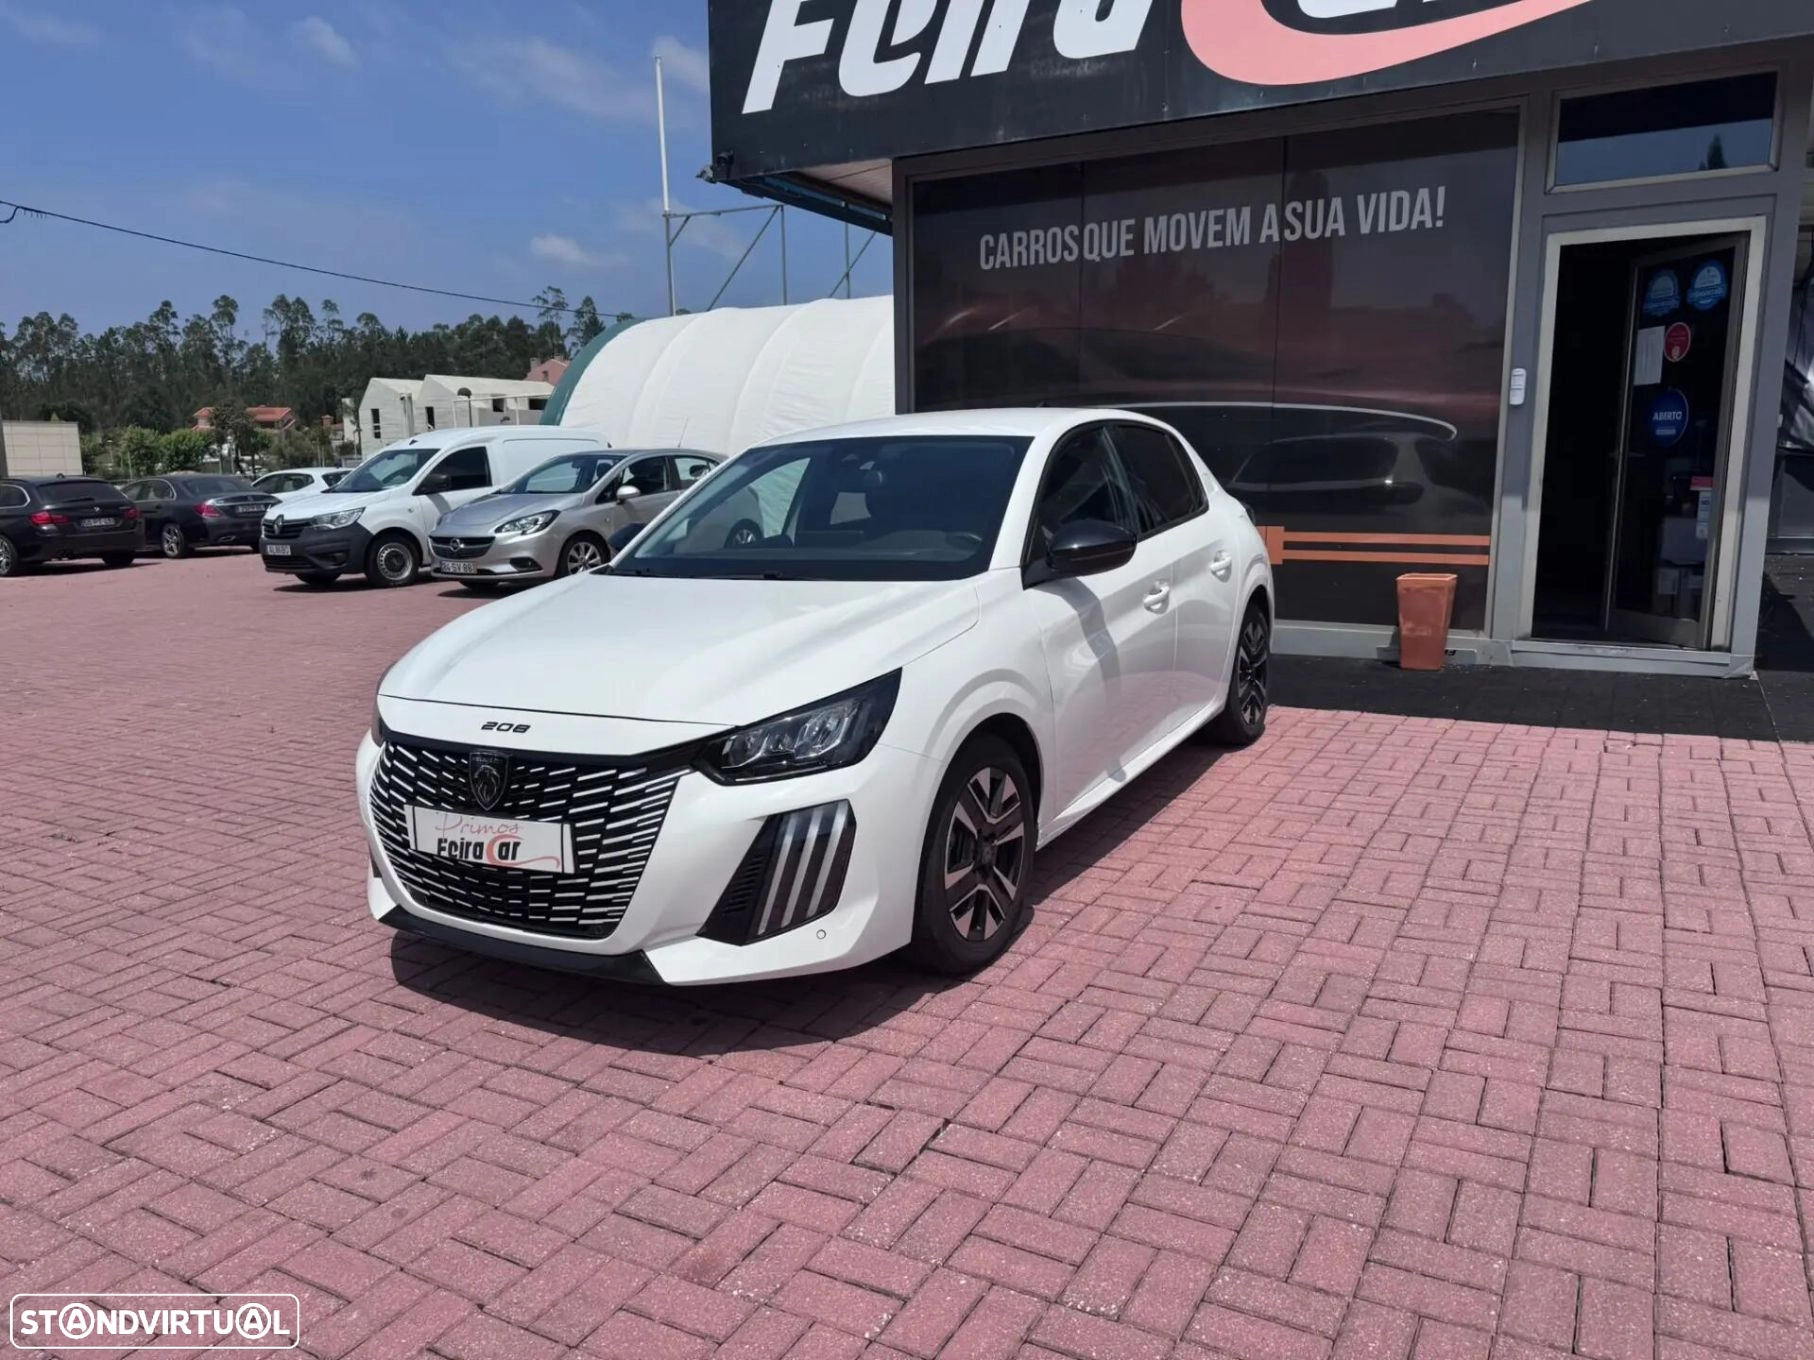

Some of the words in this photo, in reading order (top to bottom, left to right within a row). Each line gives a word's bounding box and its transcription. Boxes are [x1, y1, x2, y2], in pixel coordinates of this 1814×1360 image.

[979, 225, 1079, 270] CARROS
[1082, 218, 1136, 262] QUE
[1143, 206, 1251, 254] MOVEM
[1258, 203, 1280, 244] A
[1283, 196, 1346, 242] SUA
[1356, 185, 1446, 235] VIDA!
[481, 721, 531, 733] 208
[437, 834, 524, 866] FeiraCar
